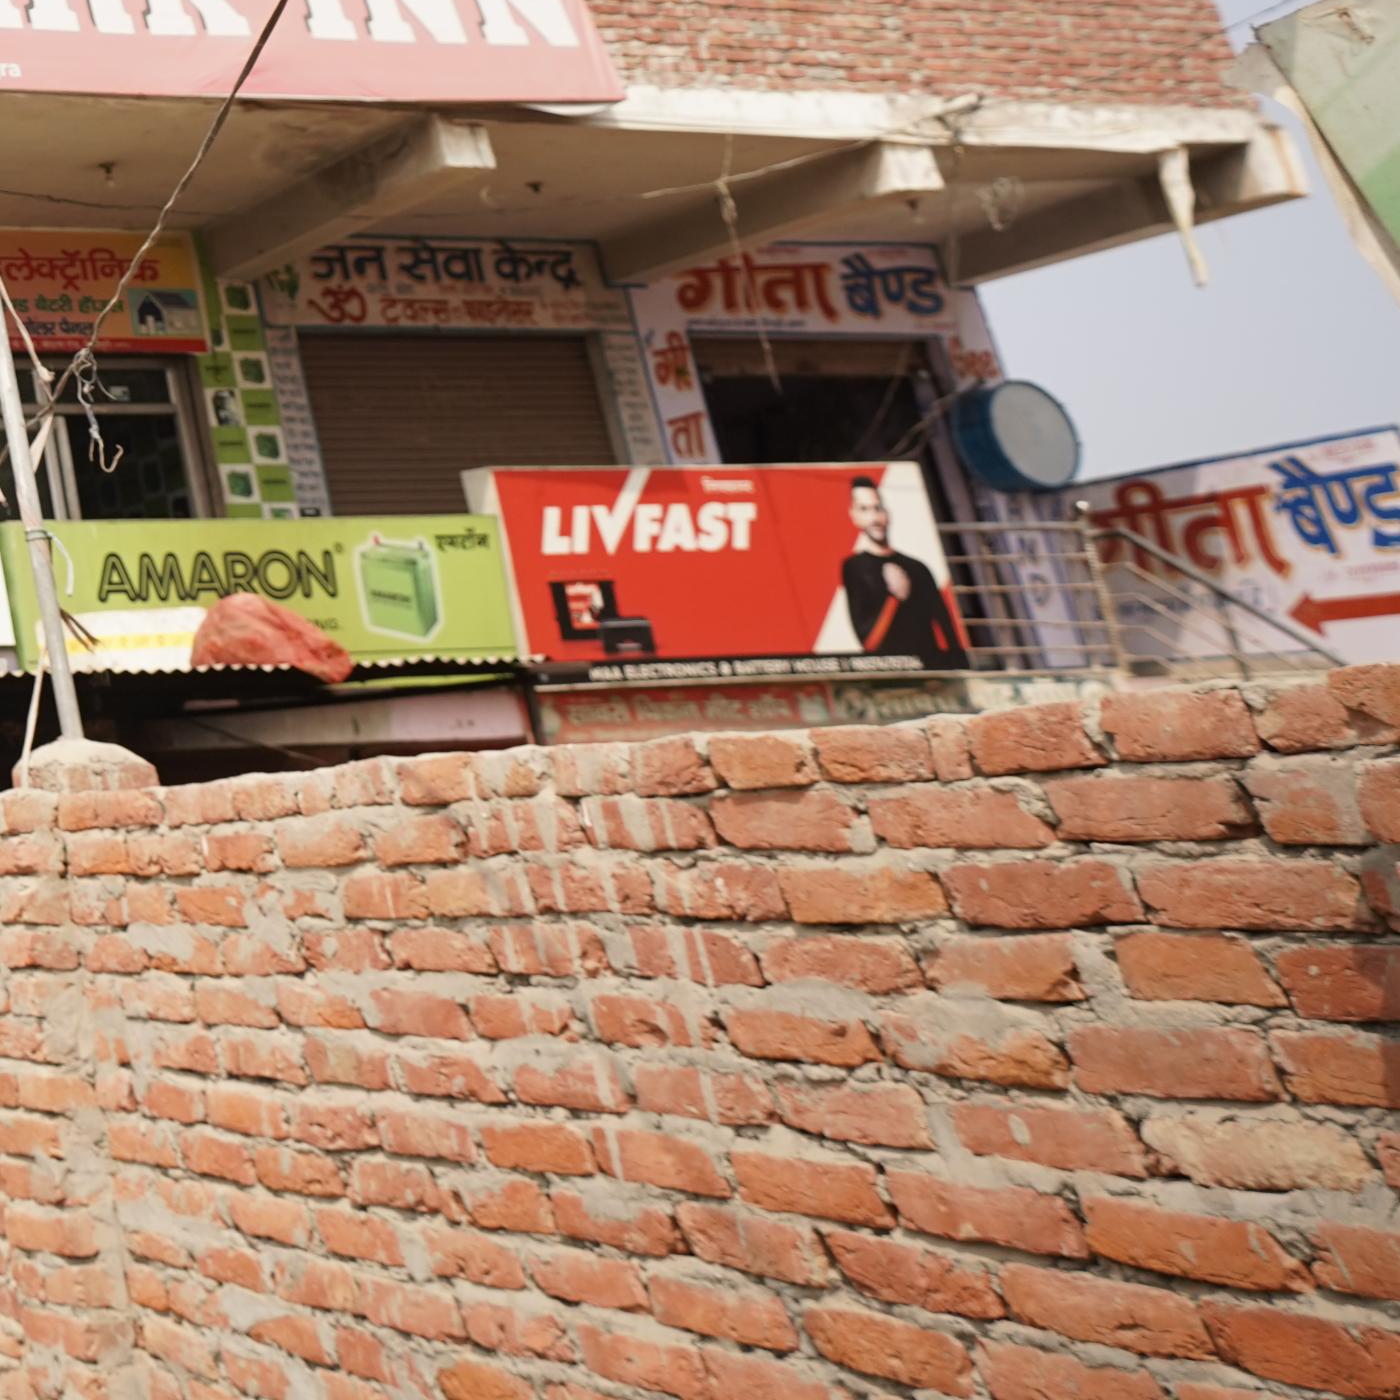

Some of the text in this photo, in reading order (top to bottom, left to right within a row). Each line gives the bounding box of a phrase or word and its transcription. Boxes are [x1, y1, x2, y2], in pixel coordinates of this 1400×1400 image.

[310, 239, 581, 290] जन सेवा केन्द्र
[840, 253, 945, 318] बैण्ड
[541, 468, 757, 555] LIVFAST
[99, 549, 338, 602] AMARON
